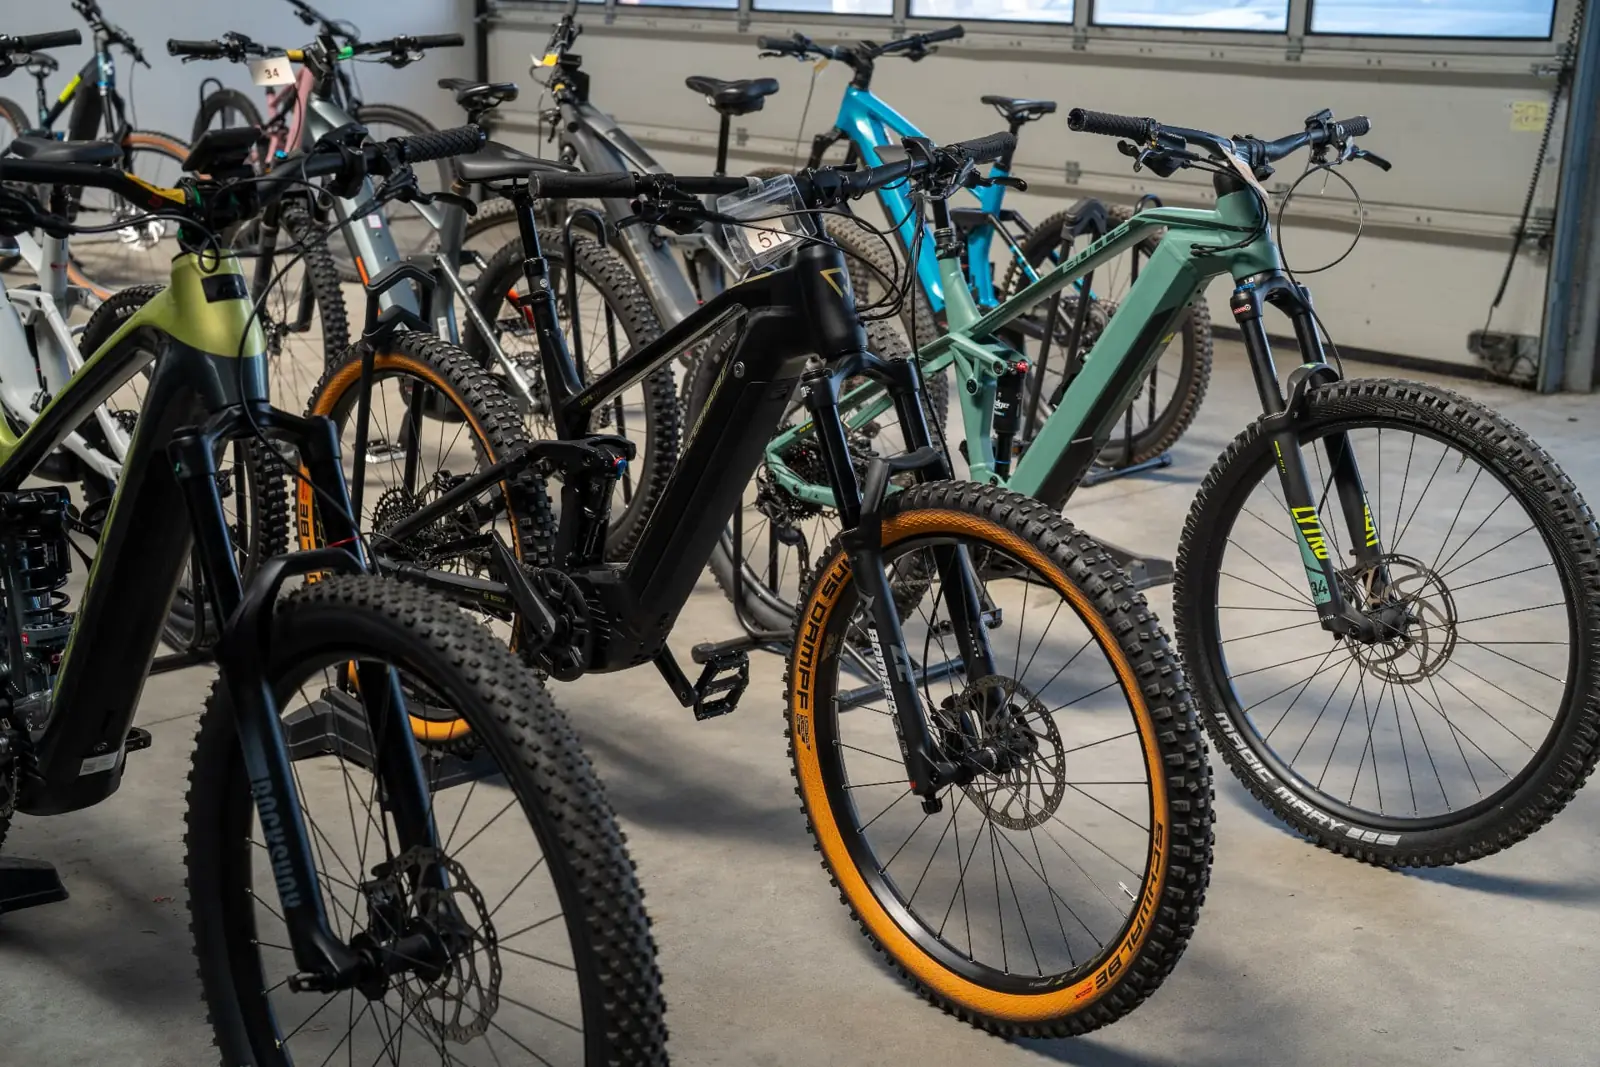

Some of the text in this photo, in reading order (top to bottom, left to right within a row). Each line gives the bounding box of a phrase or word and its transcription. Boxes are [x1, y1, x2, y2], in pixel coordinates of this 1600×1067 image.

[264, 68, 279, 79] 34
[757, 227, 783, 248] 51
[1063, 224, 1131, 273] BULLS
[1310, 580, 1328, 597] 34
[797, 601, 827, 710] DAMPF
[867, 628, 898, 716] BOMBER
[1214, 712, 1345, 831] MAGIC MARY
[1096, 820, 1164, 990] SCHWALBE
